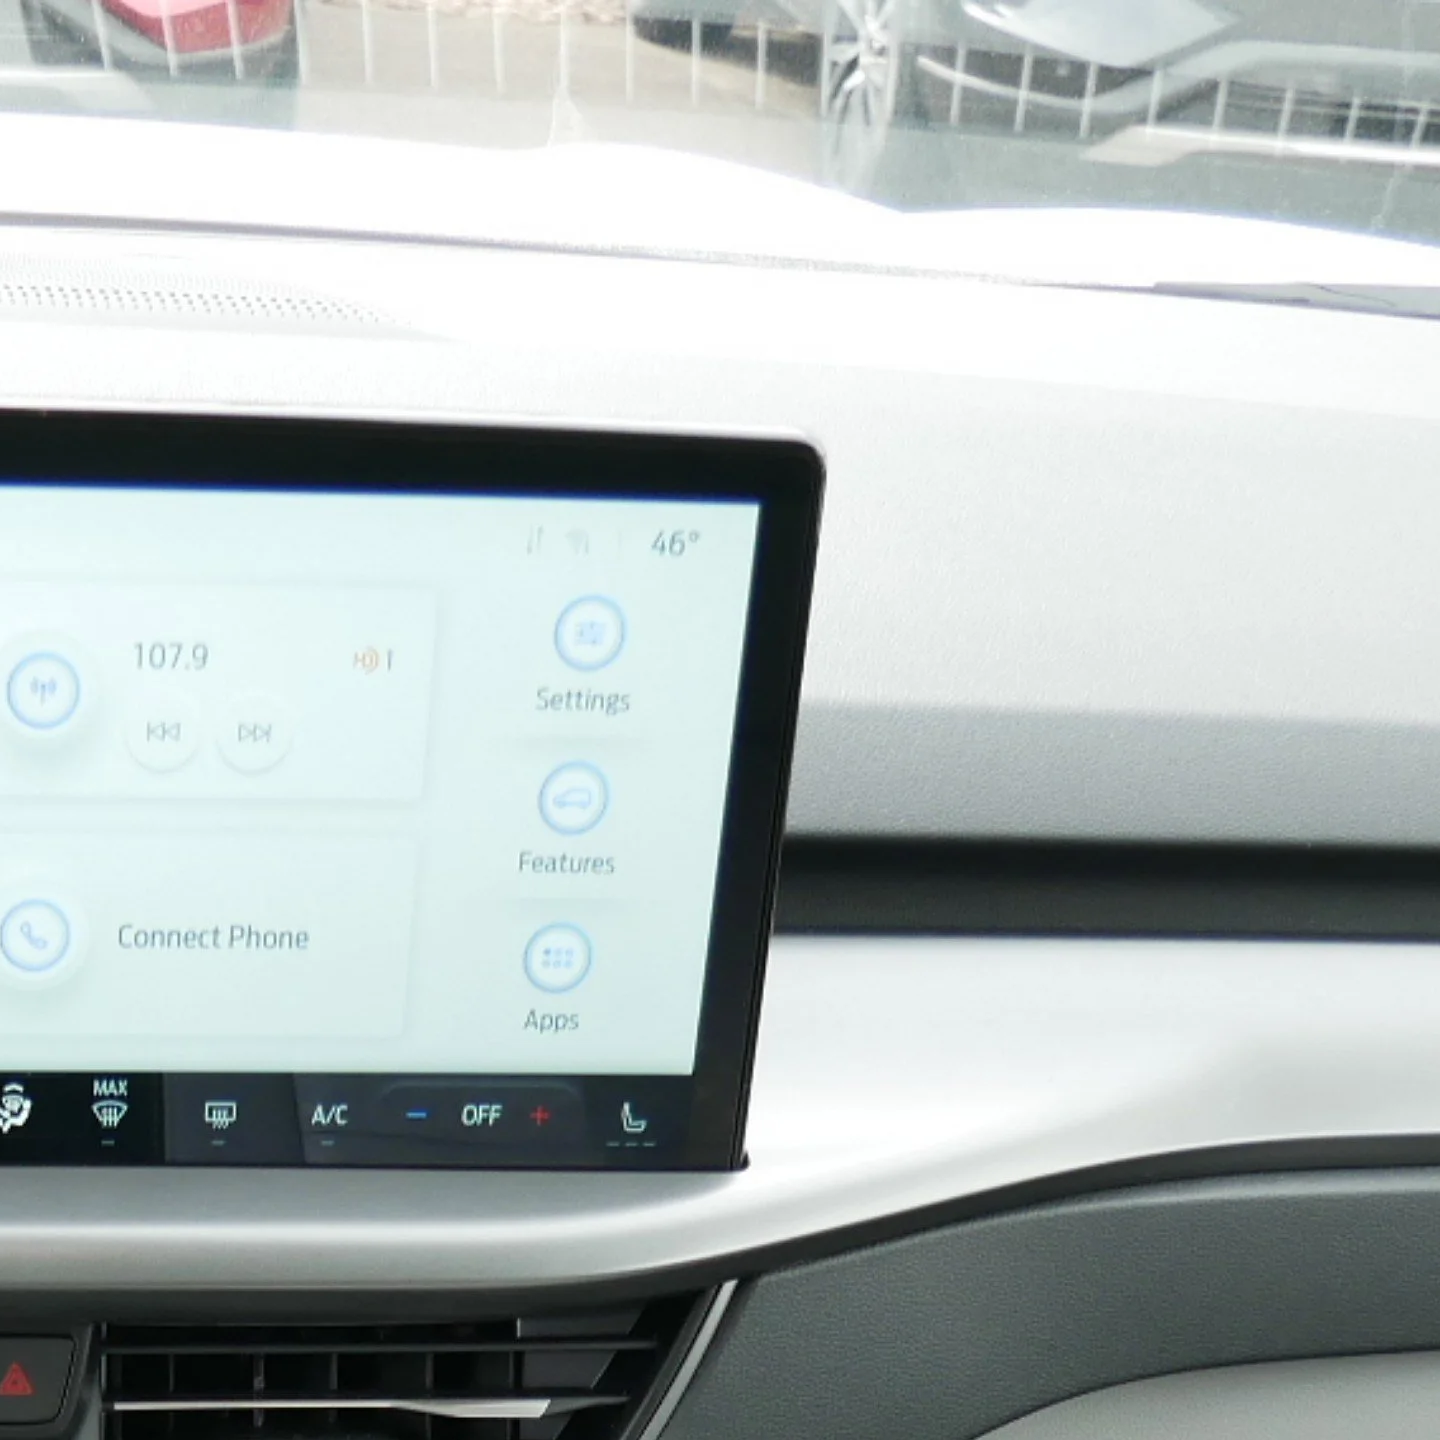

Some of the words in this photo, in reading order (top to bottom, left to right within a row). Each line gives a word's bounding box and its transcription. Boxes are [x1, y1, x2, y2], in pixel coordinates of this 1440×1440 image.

[134, 641, 229, 671] 107.9
[535, 686, 631, 717] Settings
[518, 850, 617, 878] Features
[116, 923, 223, 952] Connect
[228, 923, 310, 951] Phone
[523, 1008, 581, 1035] Apps
[92, 1079, 129, 1098] MAX
[310, 1104, 350, 1129] A/C
[460, 1104, 503, 1128] OFF
